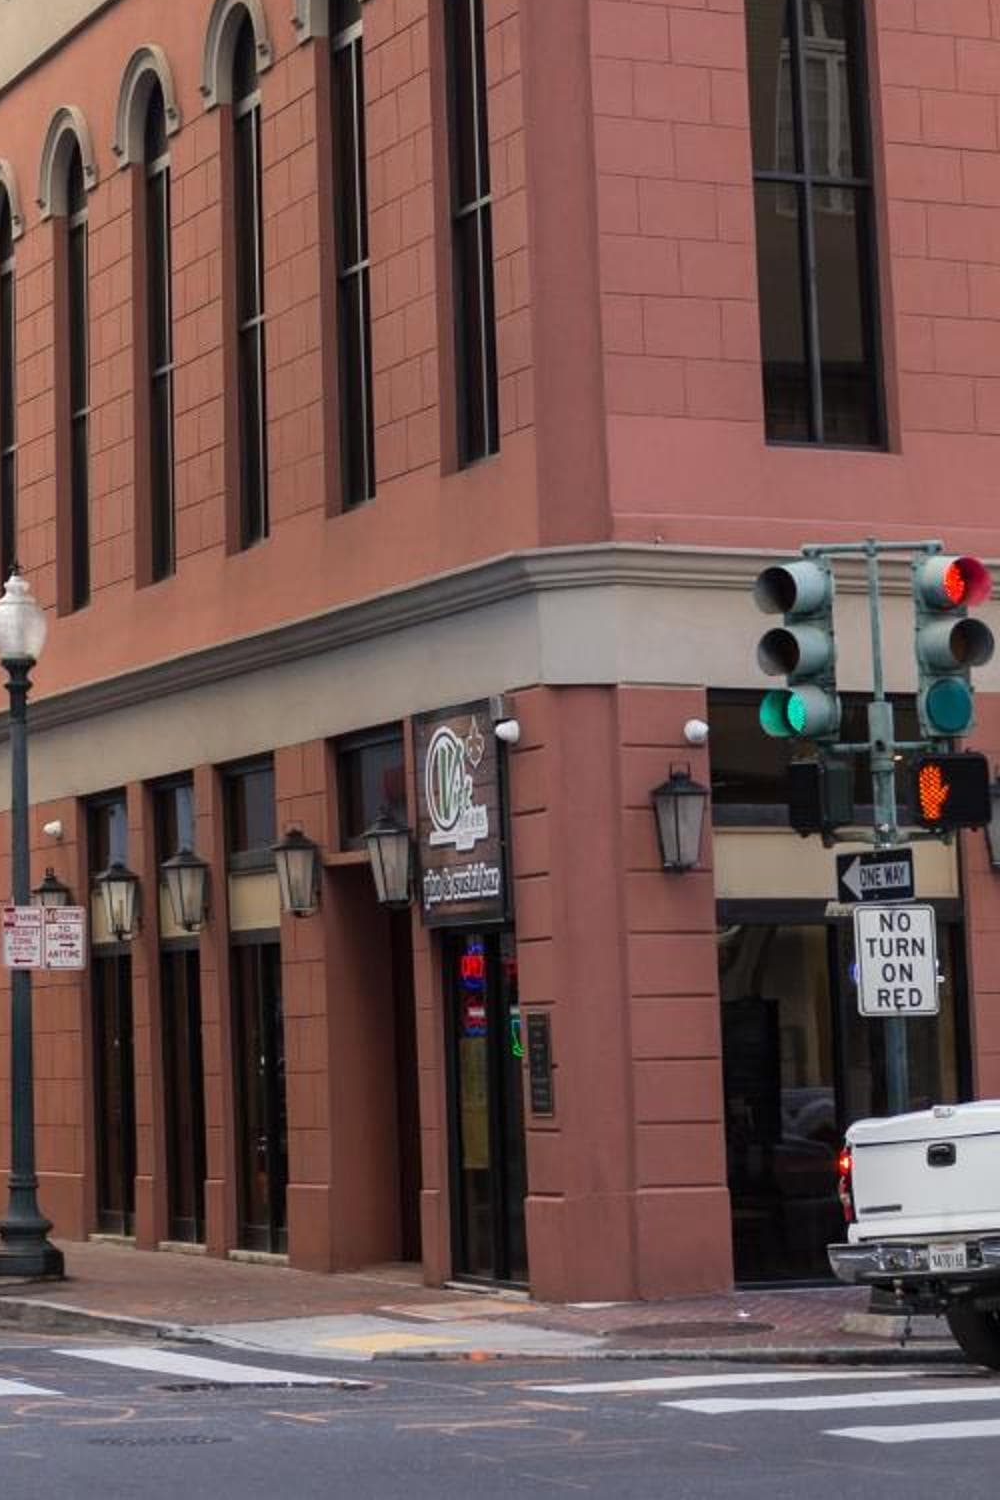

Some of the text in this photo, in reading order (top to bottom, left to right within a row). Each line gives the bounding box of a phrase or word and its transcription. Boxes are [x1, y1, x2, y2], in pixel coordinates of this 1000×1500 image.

[859, 863, 906, 888] ONE WAY
[879, 912, 911, 933] NO
[866, 937, 925, 957] TURN
[881, 963, 913, 983] ON
[876, 987, 923, 1008] RED
